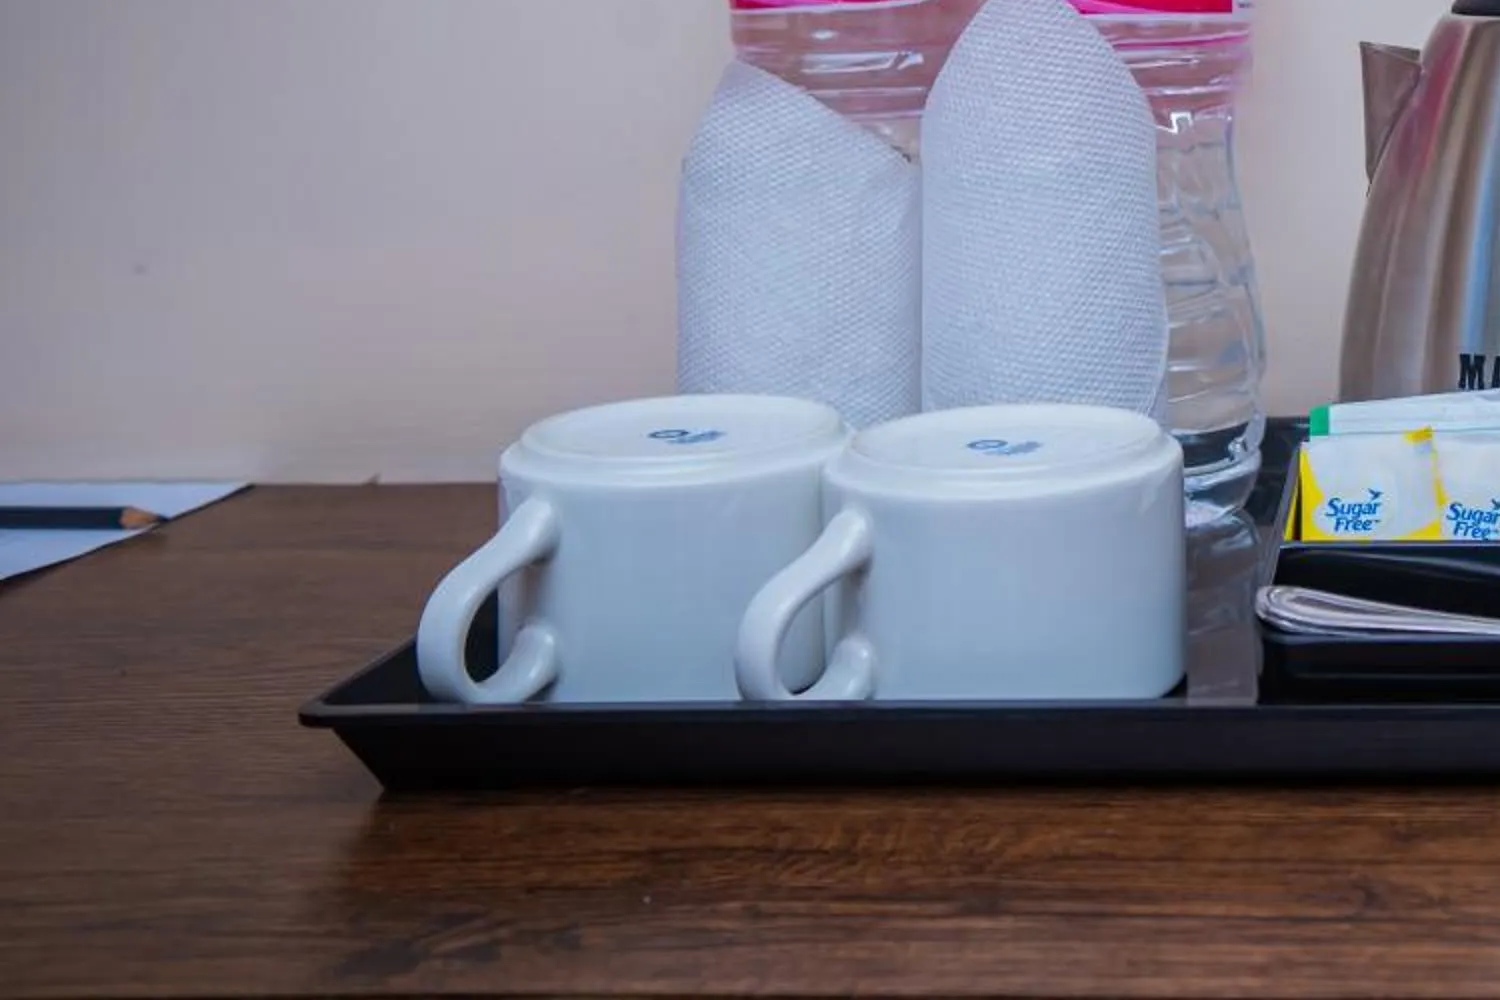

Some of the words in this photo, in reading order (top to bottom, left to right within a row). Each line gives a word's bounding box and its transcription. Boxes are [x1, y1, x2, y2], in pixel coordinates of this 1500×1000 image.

[1325, 497, 1382, 521] Sugar
[1333, 516, 1374, 532] Free
[1453, 521, 1493, 541] Free
